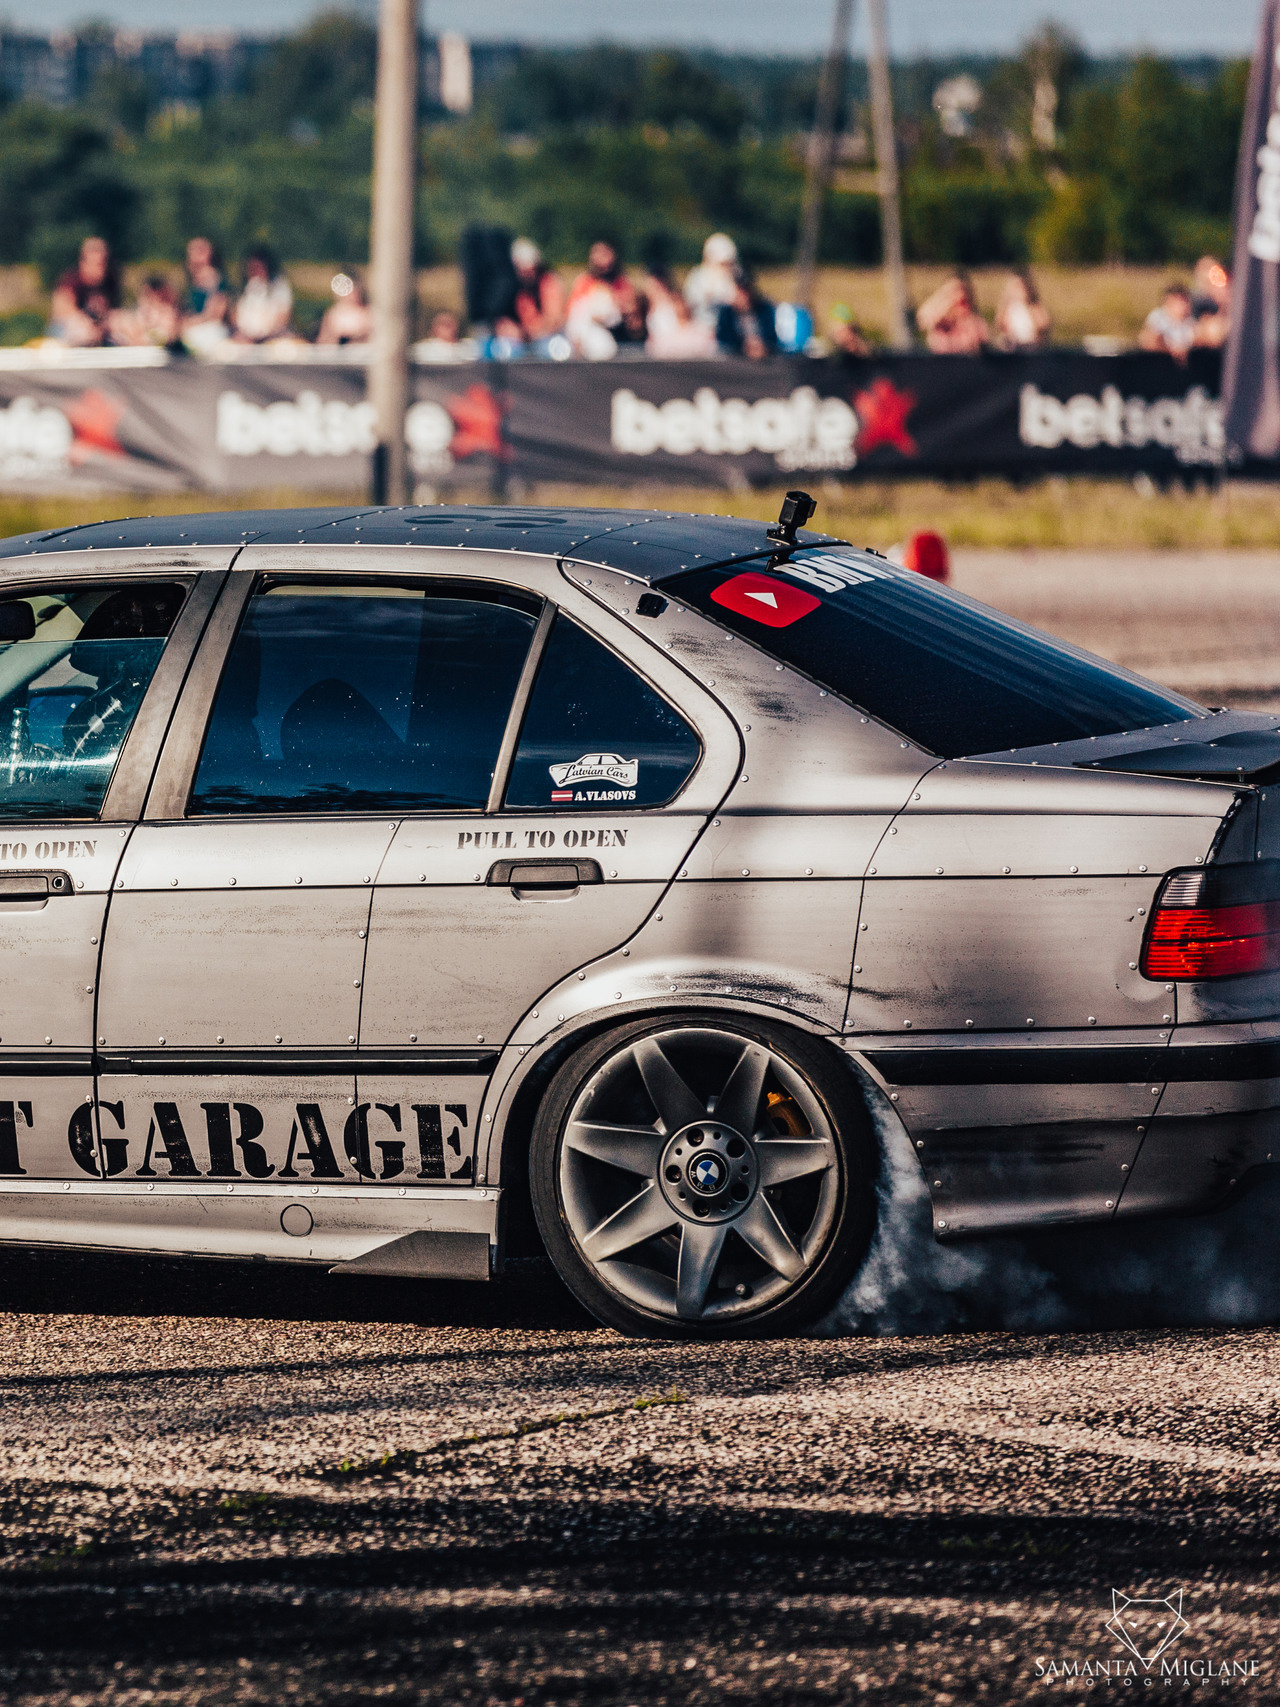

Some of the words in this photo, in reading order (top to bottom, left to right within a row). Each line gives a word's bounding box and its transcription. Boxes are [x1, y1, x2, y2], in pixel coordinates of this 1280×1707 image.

[217, 390, 454, 456] betsae
[610, 385, 859, 456] betsafe
[559, 764, 603, 784] Latvian
[606, 767, 628, 779] Cars
[574, 789, 636, 801] A.VLASOVS
[34, 840, 98, 859] OPEN
[457, 831, 517, 850] PULL
[524, 830, 556, 848] TO
[563, 829, 629, 848] OPEN
[67, 1100, 474, 1180] GARAGE
